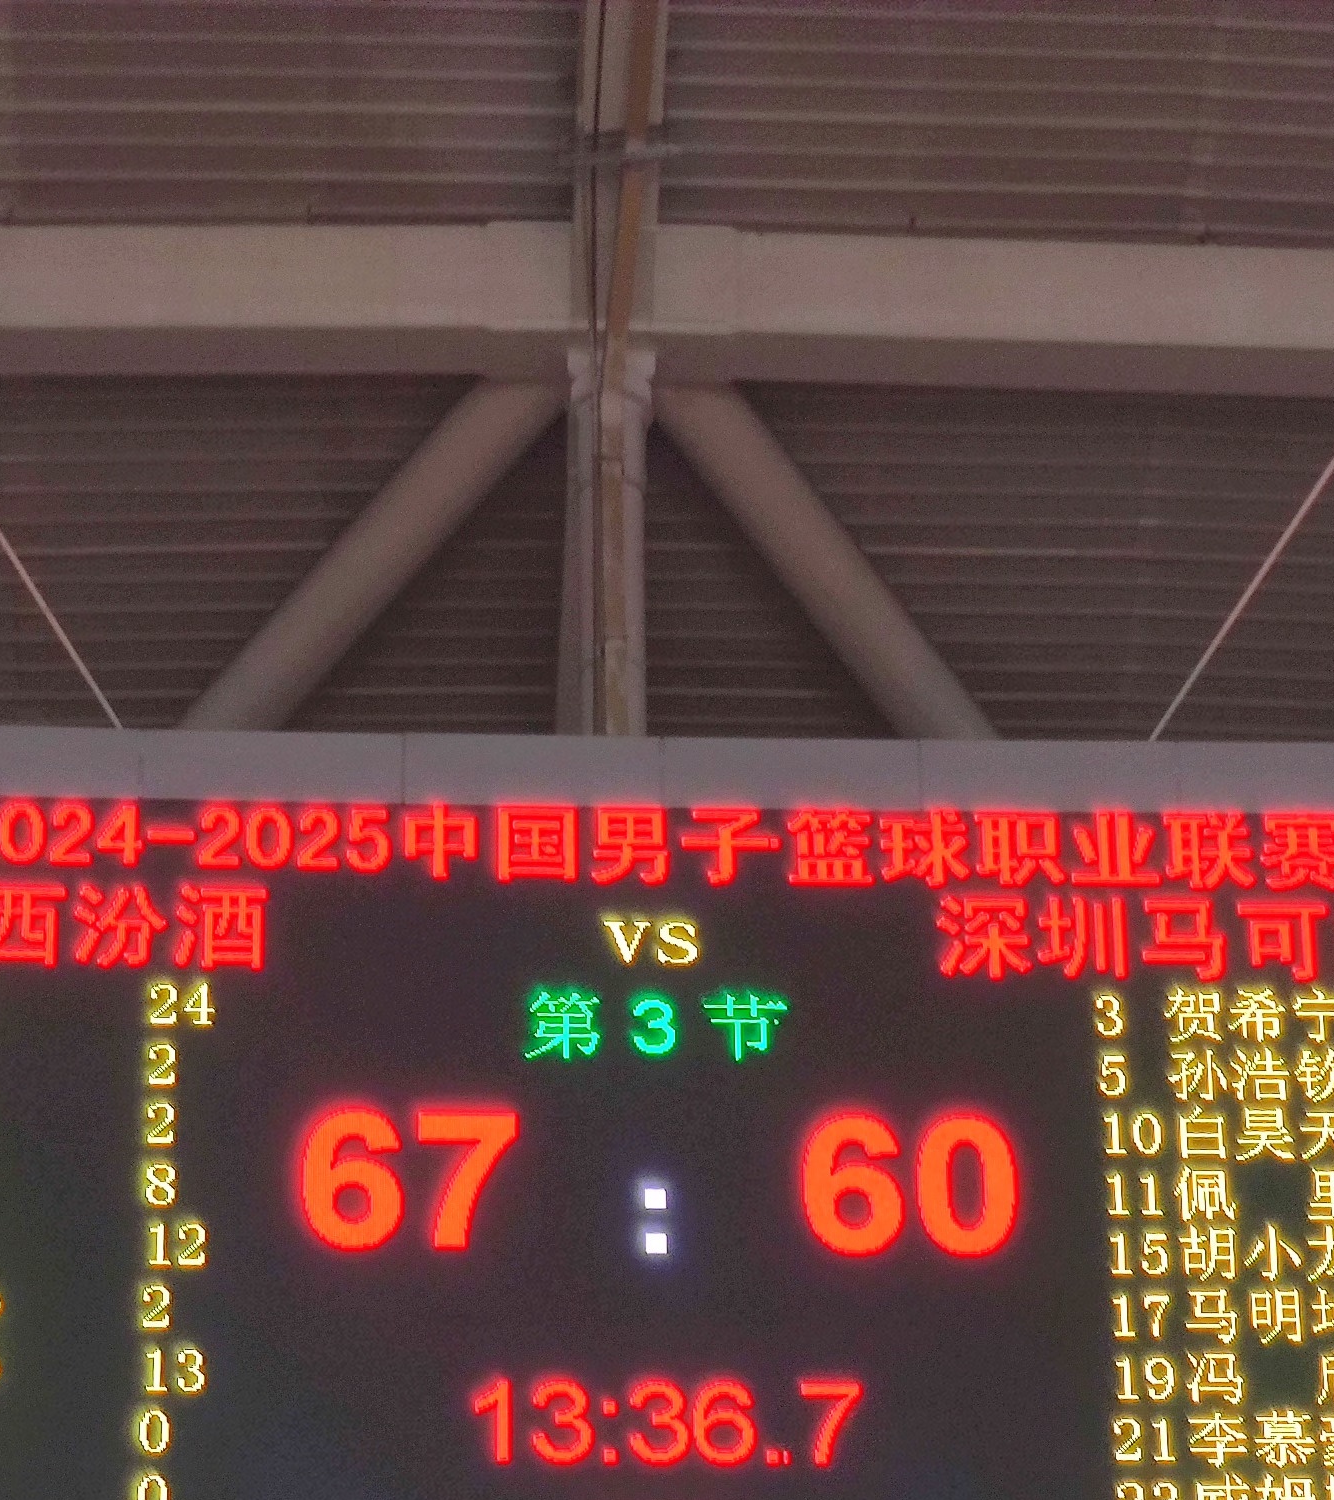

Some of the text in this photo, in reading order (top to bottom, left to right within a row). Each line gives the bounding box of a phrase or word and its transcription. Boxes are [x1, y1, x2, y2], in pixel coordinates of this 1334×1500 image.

[148, 981, 216, 1026] 24
[1094, 994, 1125, 1037] 3
[147, 1042, 177, 1086] 2
[1098, 1053, 1127, 1097] 5
[145, 1100, 176, 1145] 2
[1102, 1111, 1163, 1156] 10
[144, 1162, 177, 1207] 8
[297, 1106, 517, 1250] 67
[801, 1112, 1017, 1256] 60
[1105, 1172, 1165, 1217] 11
[147, 1221, 207, 1267] 12
[1108, 1230, 1170, 1276] 15
[141, 1283, 172, 1329] 2
[1111, 1292, 1171, 1339] 17
[144, 1346, 206, 1393] 13
[1114, 1355, 1176, 1401] 19
[137, 1407, 171, 1454] 0
[1112, 1416, 1177, 1463] 21
